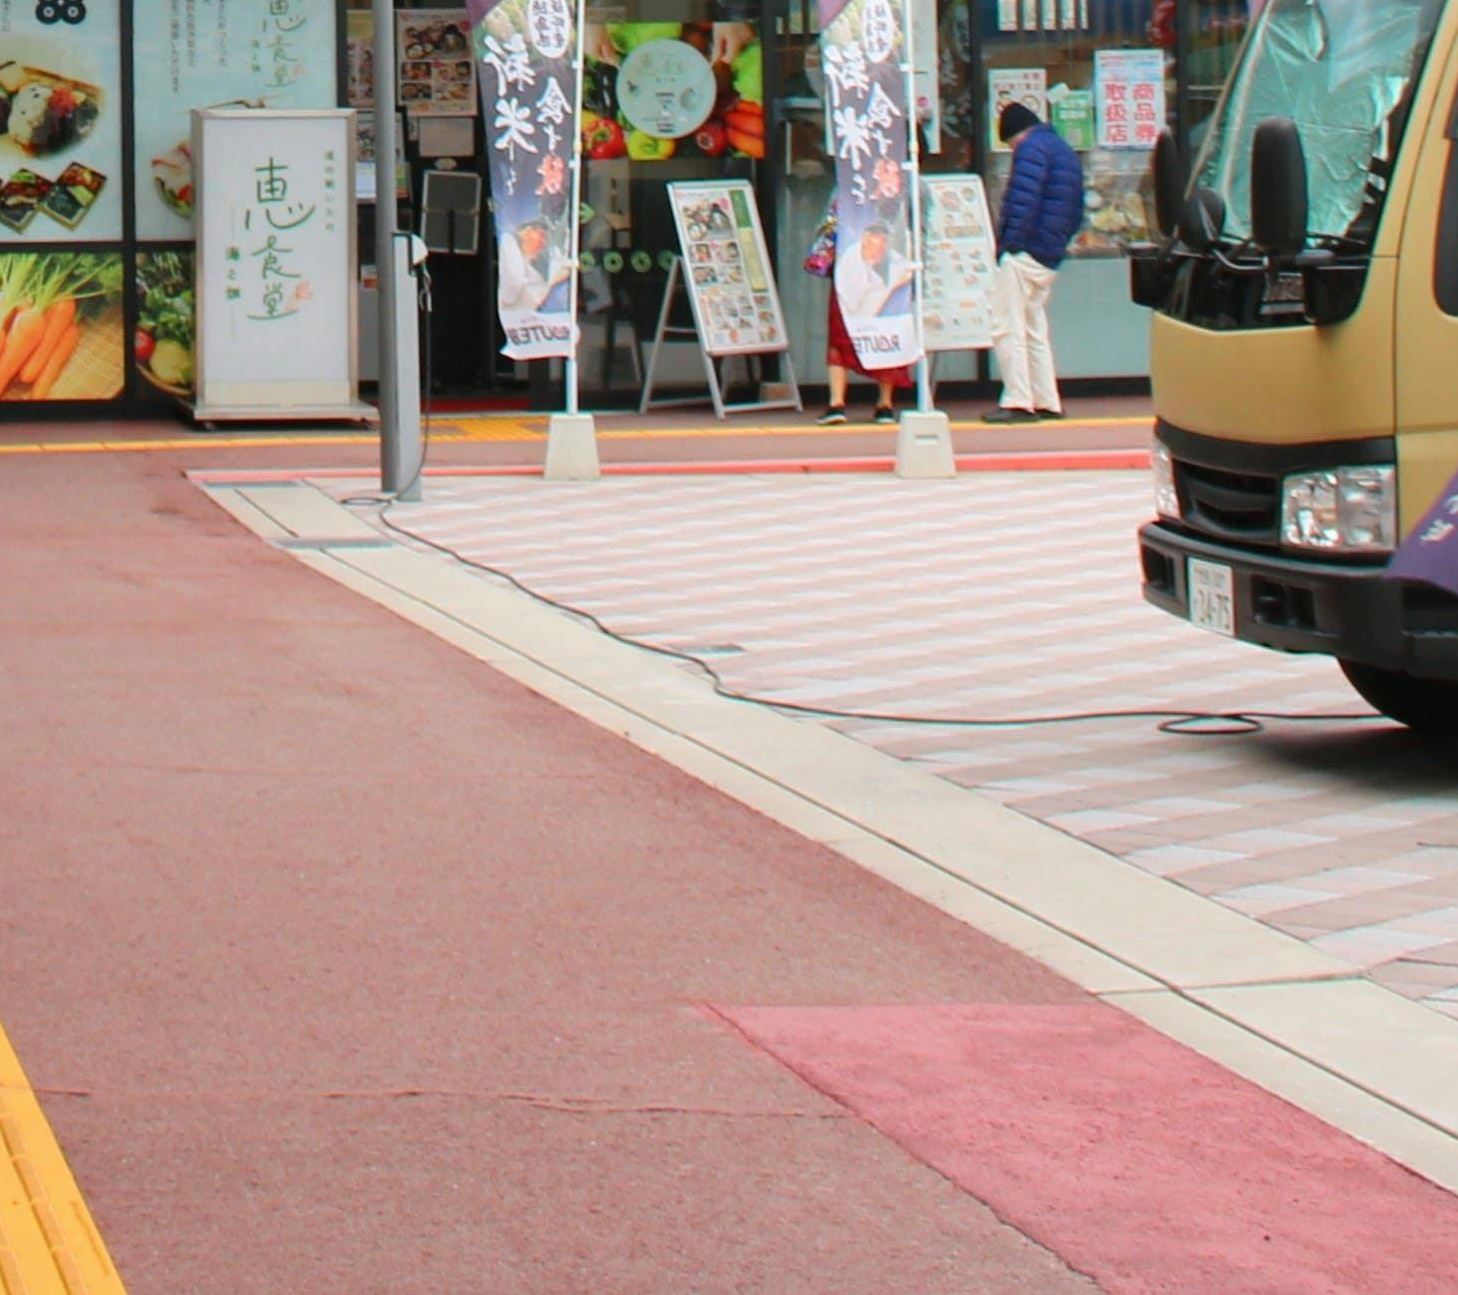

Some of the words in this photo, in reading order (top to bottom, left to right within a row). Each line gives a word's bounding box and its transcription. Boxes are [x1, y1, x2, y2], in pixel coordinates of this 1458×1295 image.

[1105, 83, 1127, 142] 取扱店
[1133, 83, 1156, 142] 商品券
[244, 156, 316, 320] 恵食堂
